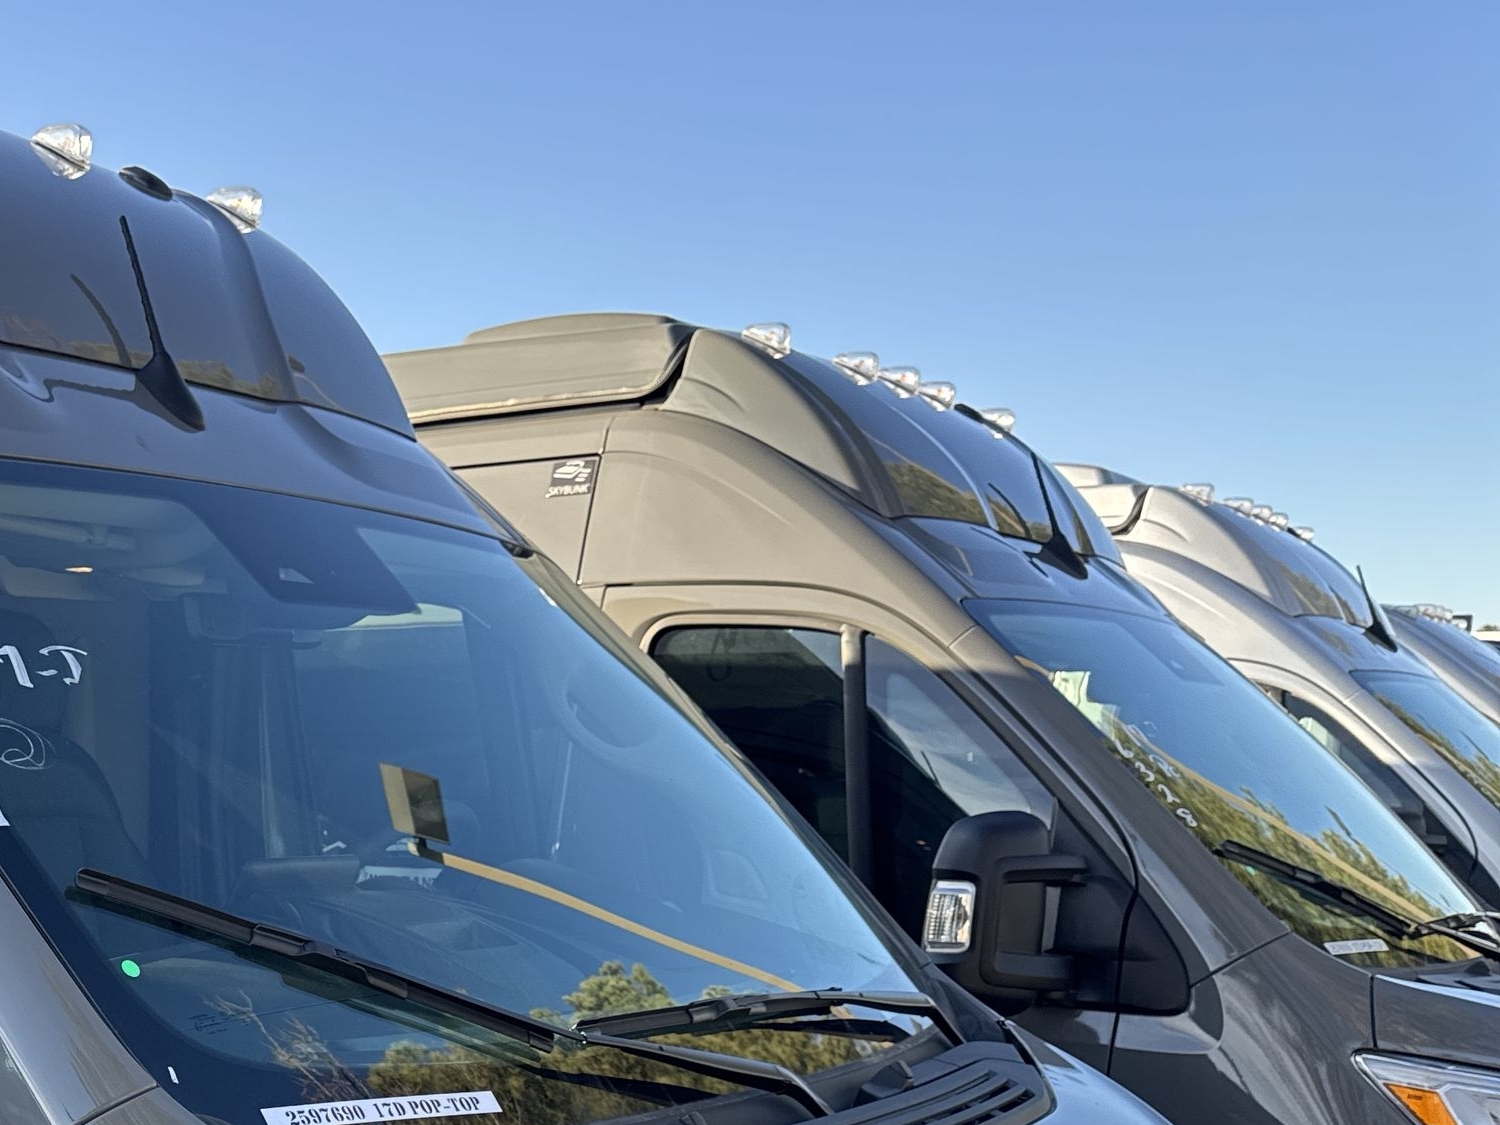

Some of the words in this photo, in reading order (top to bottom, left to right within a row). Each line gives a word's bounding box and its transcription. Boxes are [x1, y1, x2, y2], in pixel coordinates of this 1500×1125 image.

[545, 483, 591, 499] SKYBUNK
[373, 1101, 407, 1118] 17D
[407, 1096, 481, 1116] POP-TOP
